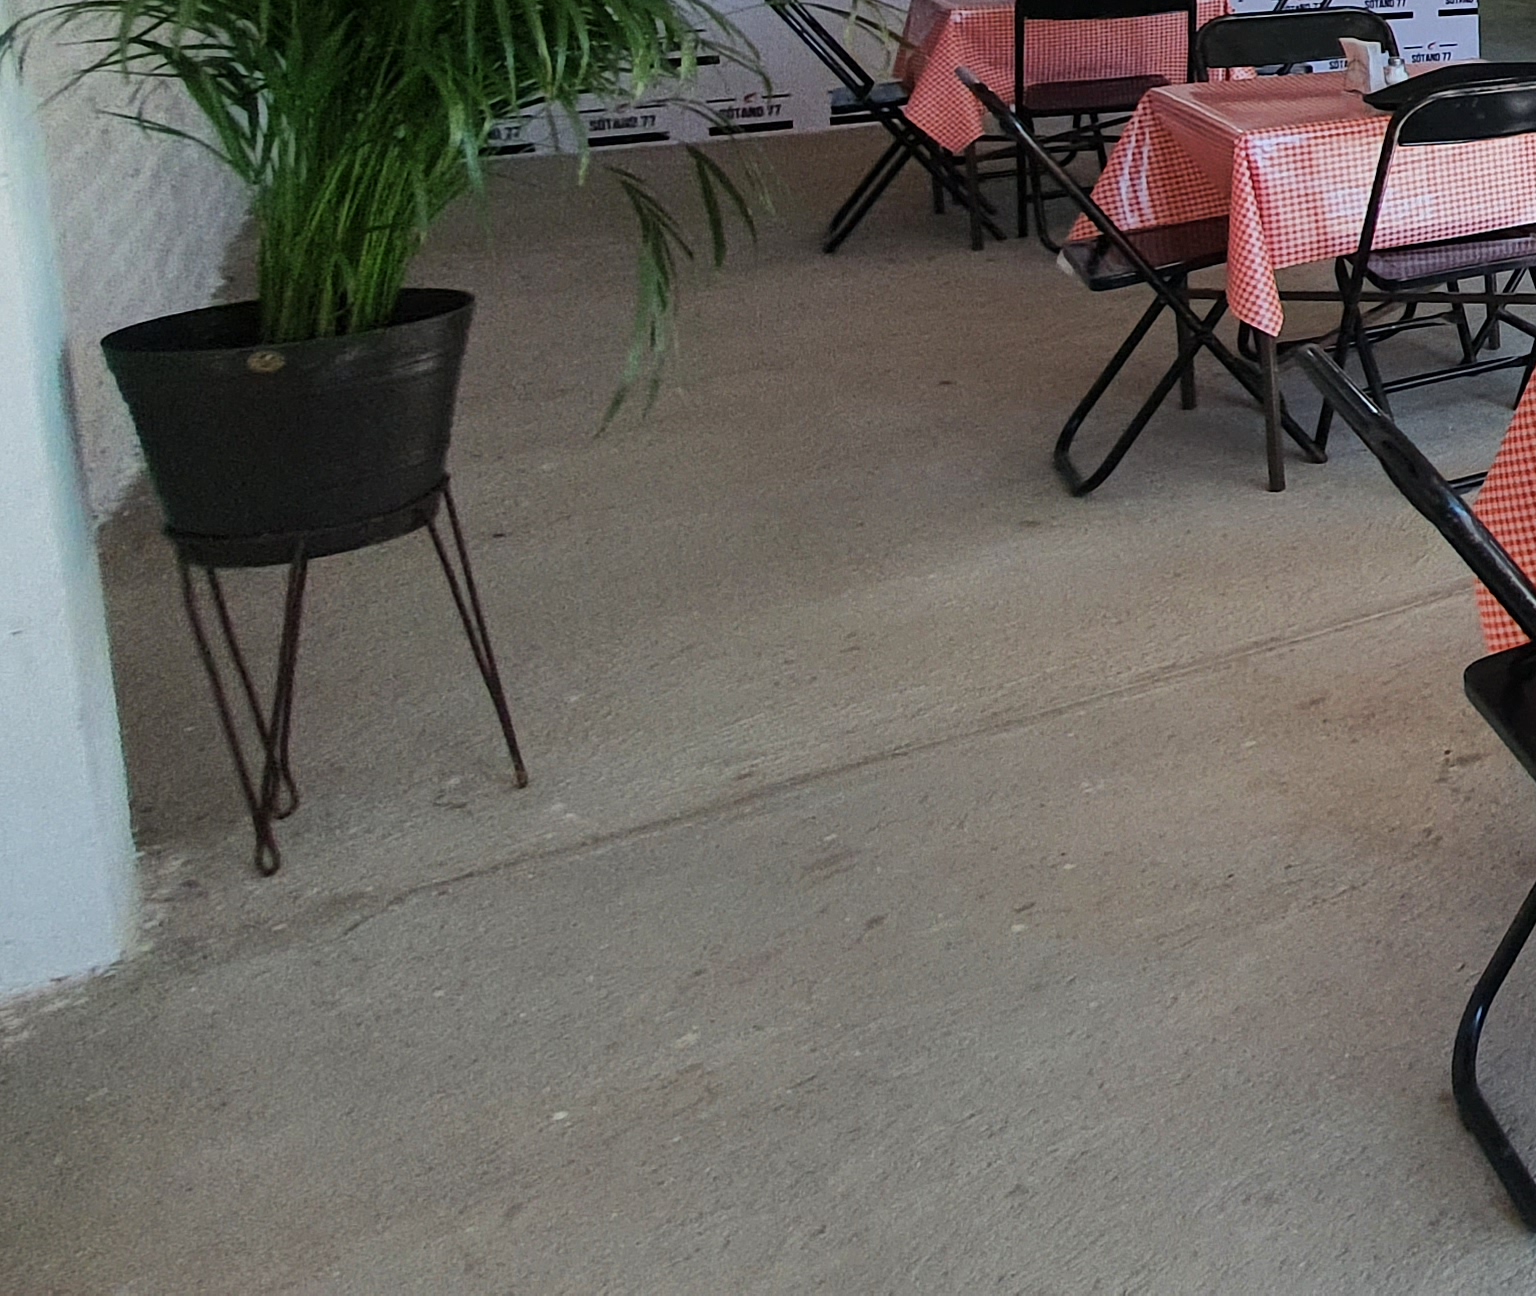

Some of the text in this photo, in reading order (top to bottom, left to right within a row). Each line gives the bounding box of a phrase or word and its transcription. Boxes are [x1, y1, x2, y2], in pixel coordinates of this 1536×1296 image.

[1364, 0, 1395, 10] SÓTANO
[1412, 52, 1452, 64] SÓTANO 77
[640, 115, 657, 128] 77
